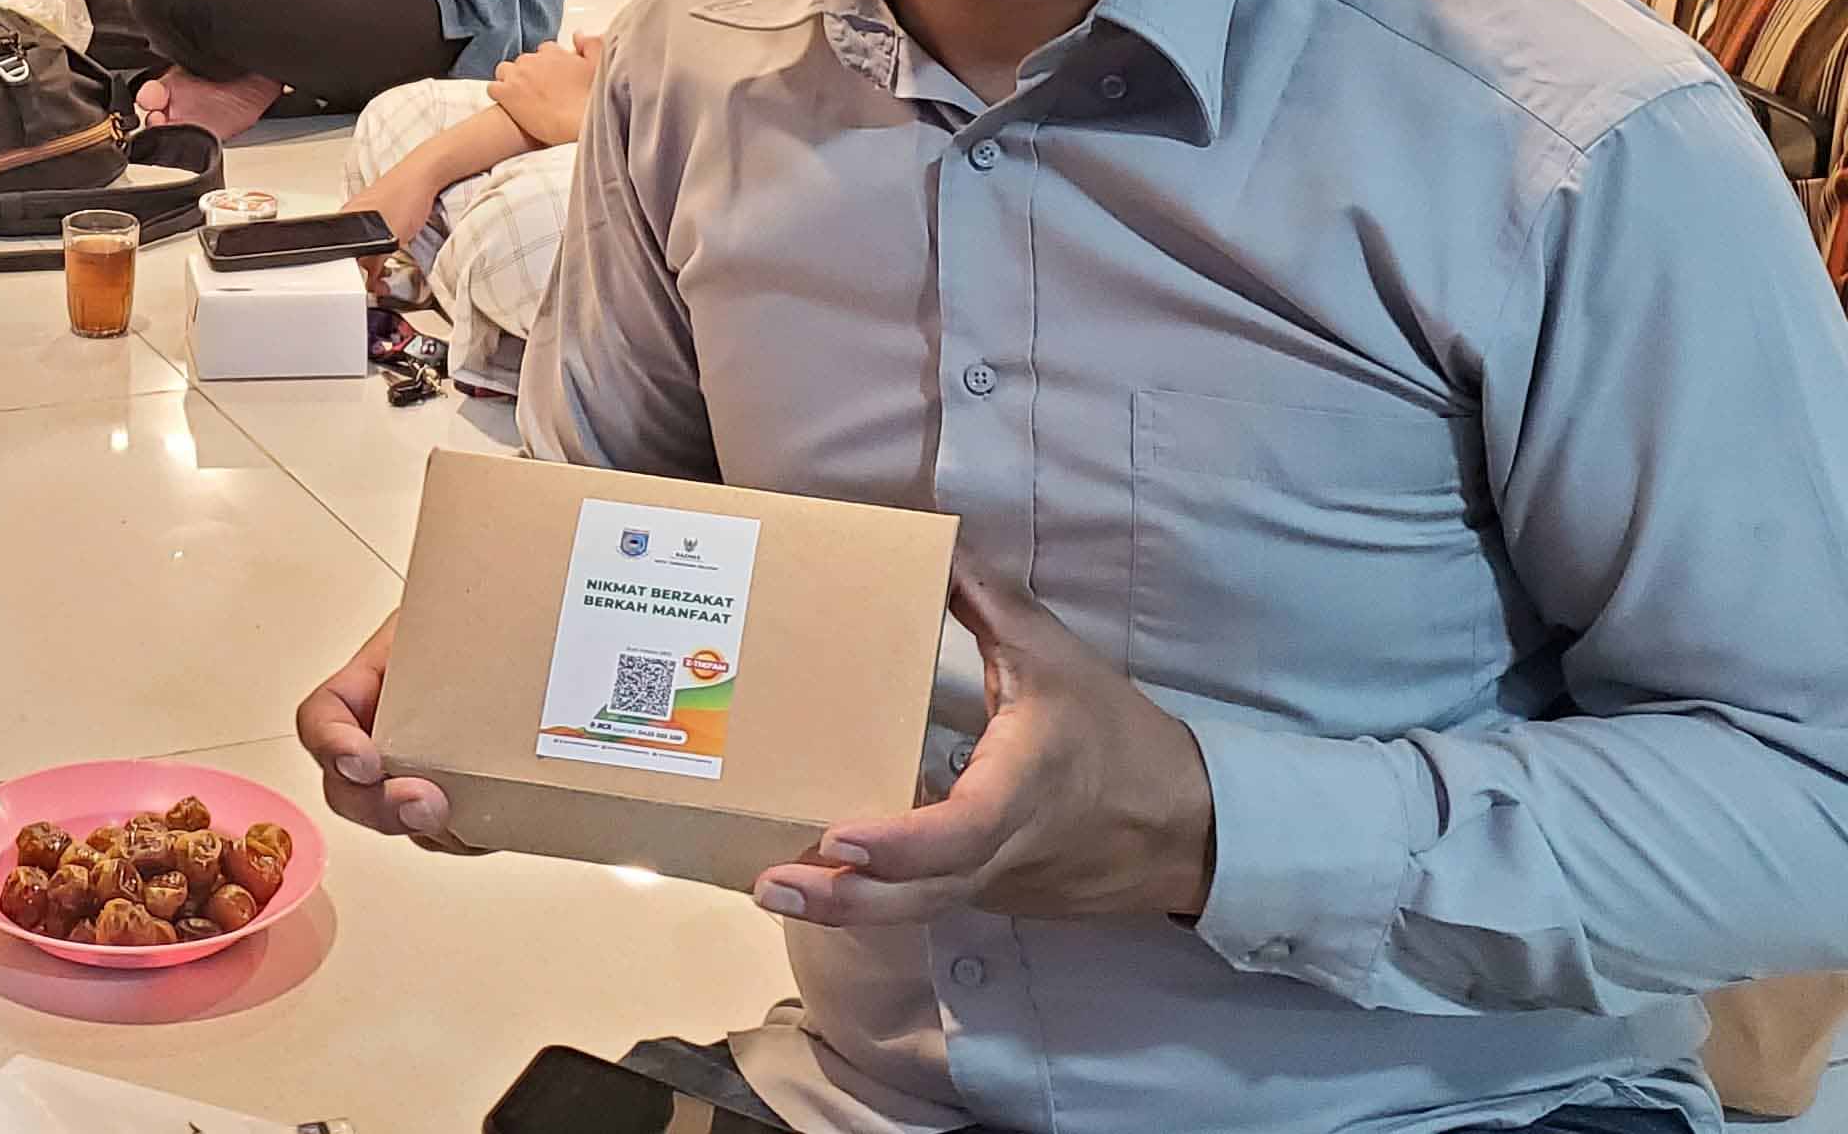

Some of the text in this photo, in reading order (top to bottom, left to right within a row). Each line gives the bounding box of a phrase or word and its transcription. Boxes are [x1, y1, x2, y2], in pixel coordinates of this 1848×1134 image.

[586, 579, 734, 608] NIKMAT BERZAKAT
[584, 595, 733, 624] BERKAH MANFAAT
